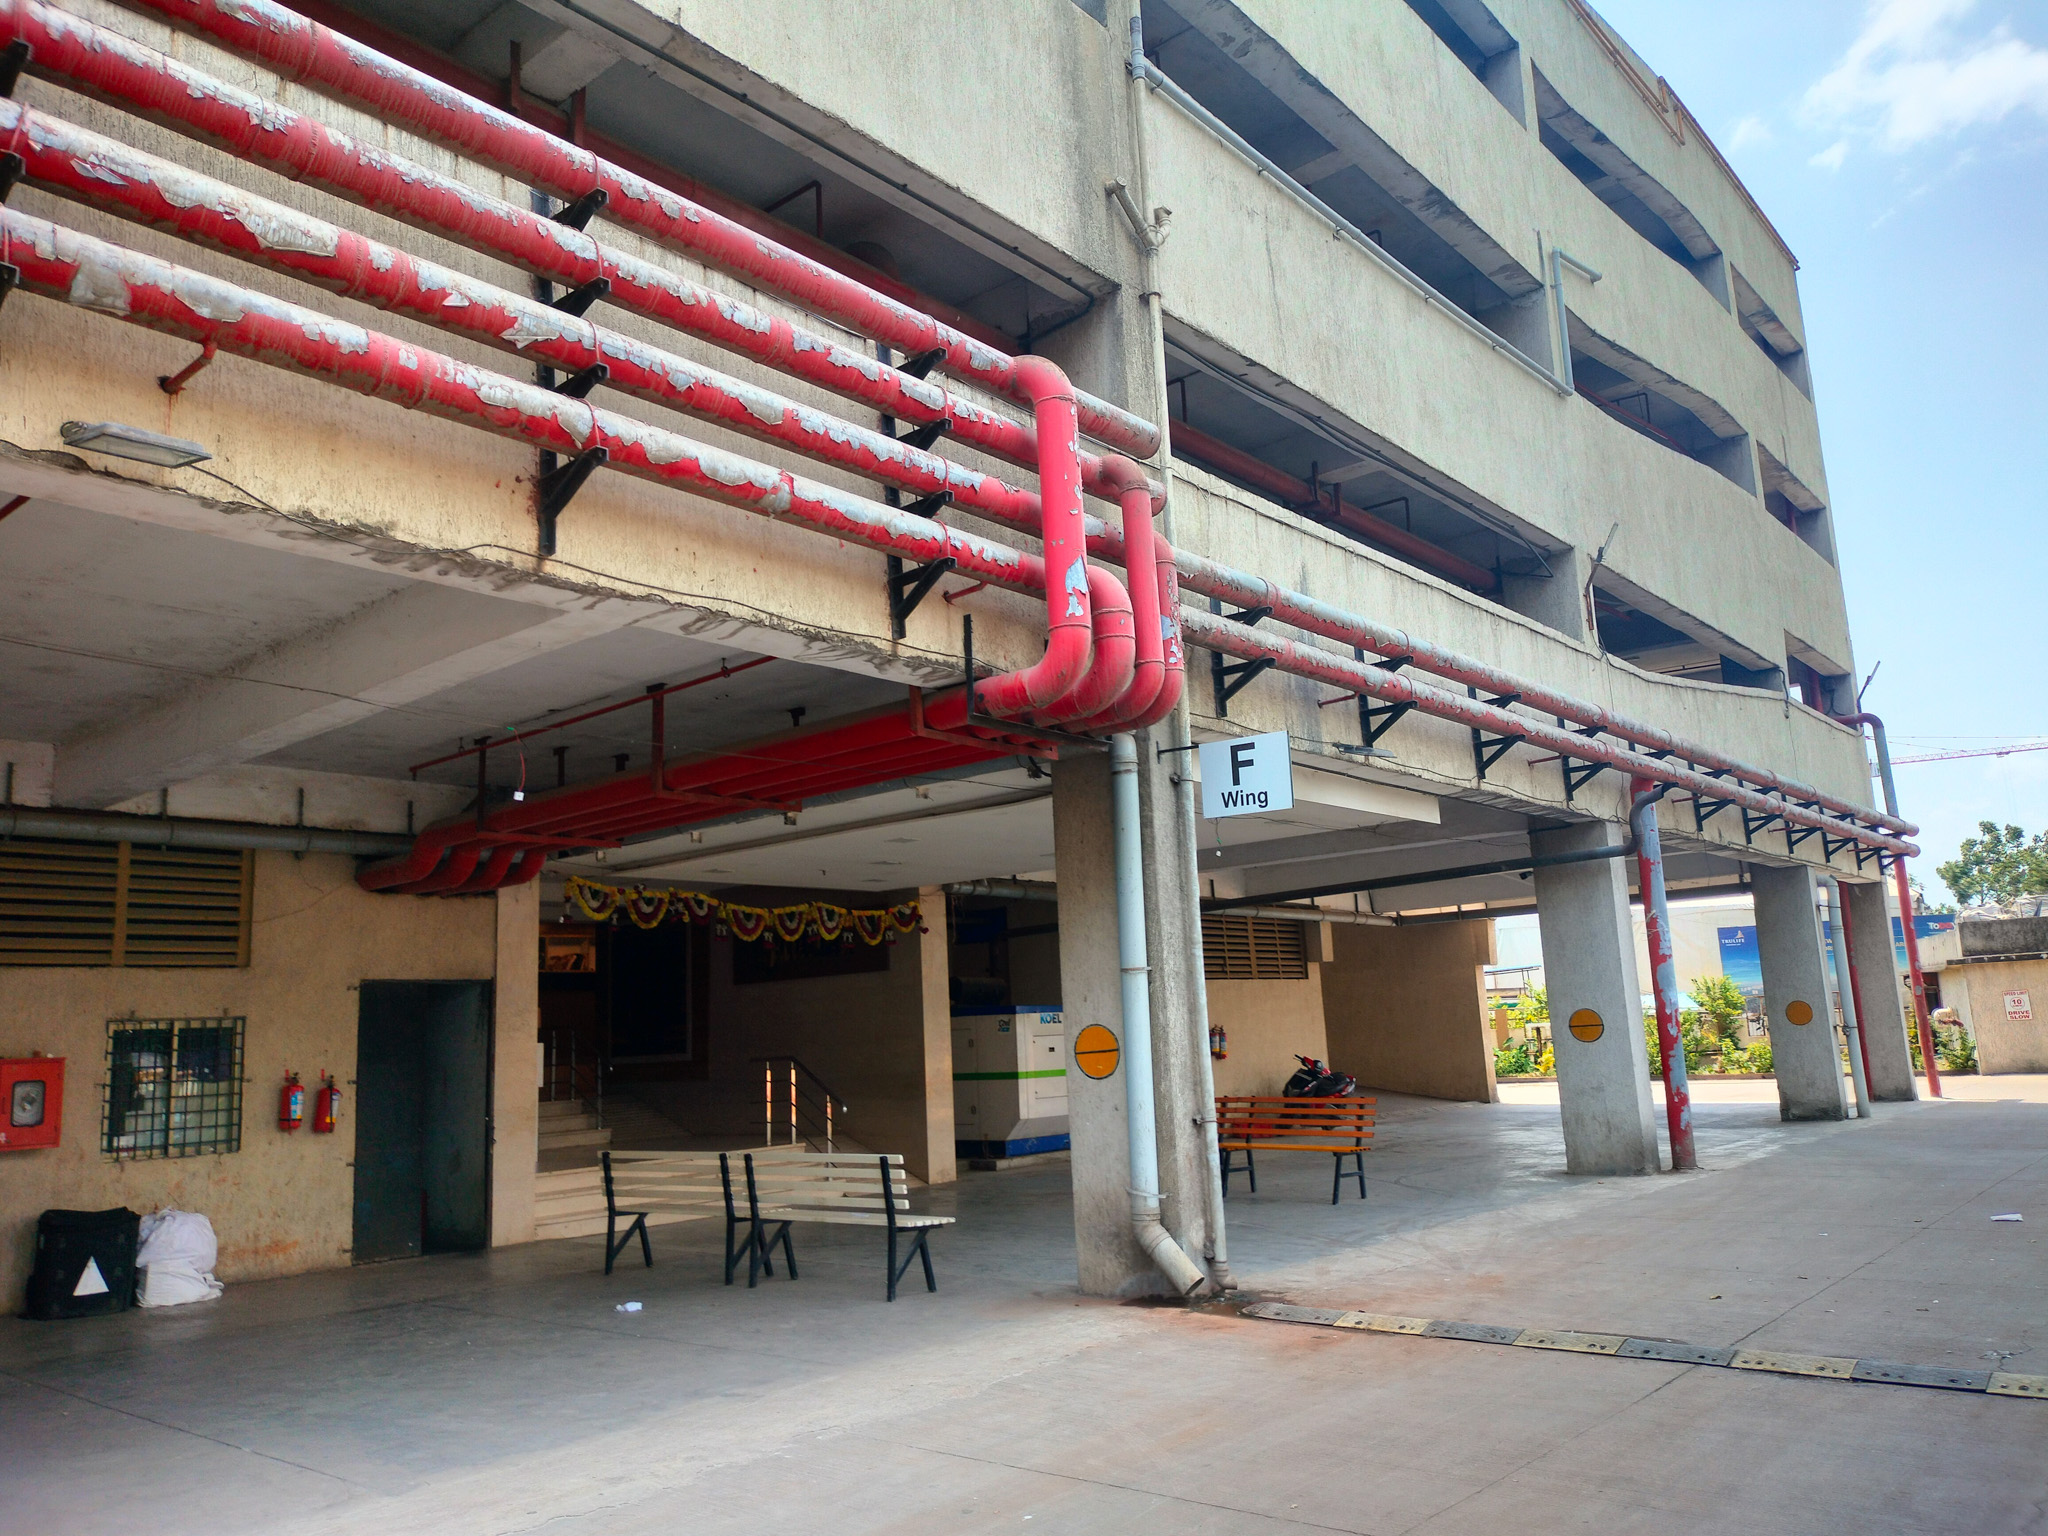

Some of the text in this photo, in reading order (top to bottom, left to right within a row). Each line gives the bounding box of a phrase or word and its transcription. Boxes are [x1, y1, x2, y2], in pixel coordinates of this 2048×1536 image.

[1230, 742, 1255, 786] F
[1221, 790, 1268, 809] Wing
[1040, 1013, 1062, 1024] KOEL
